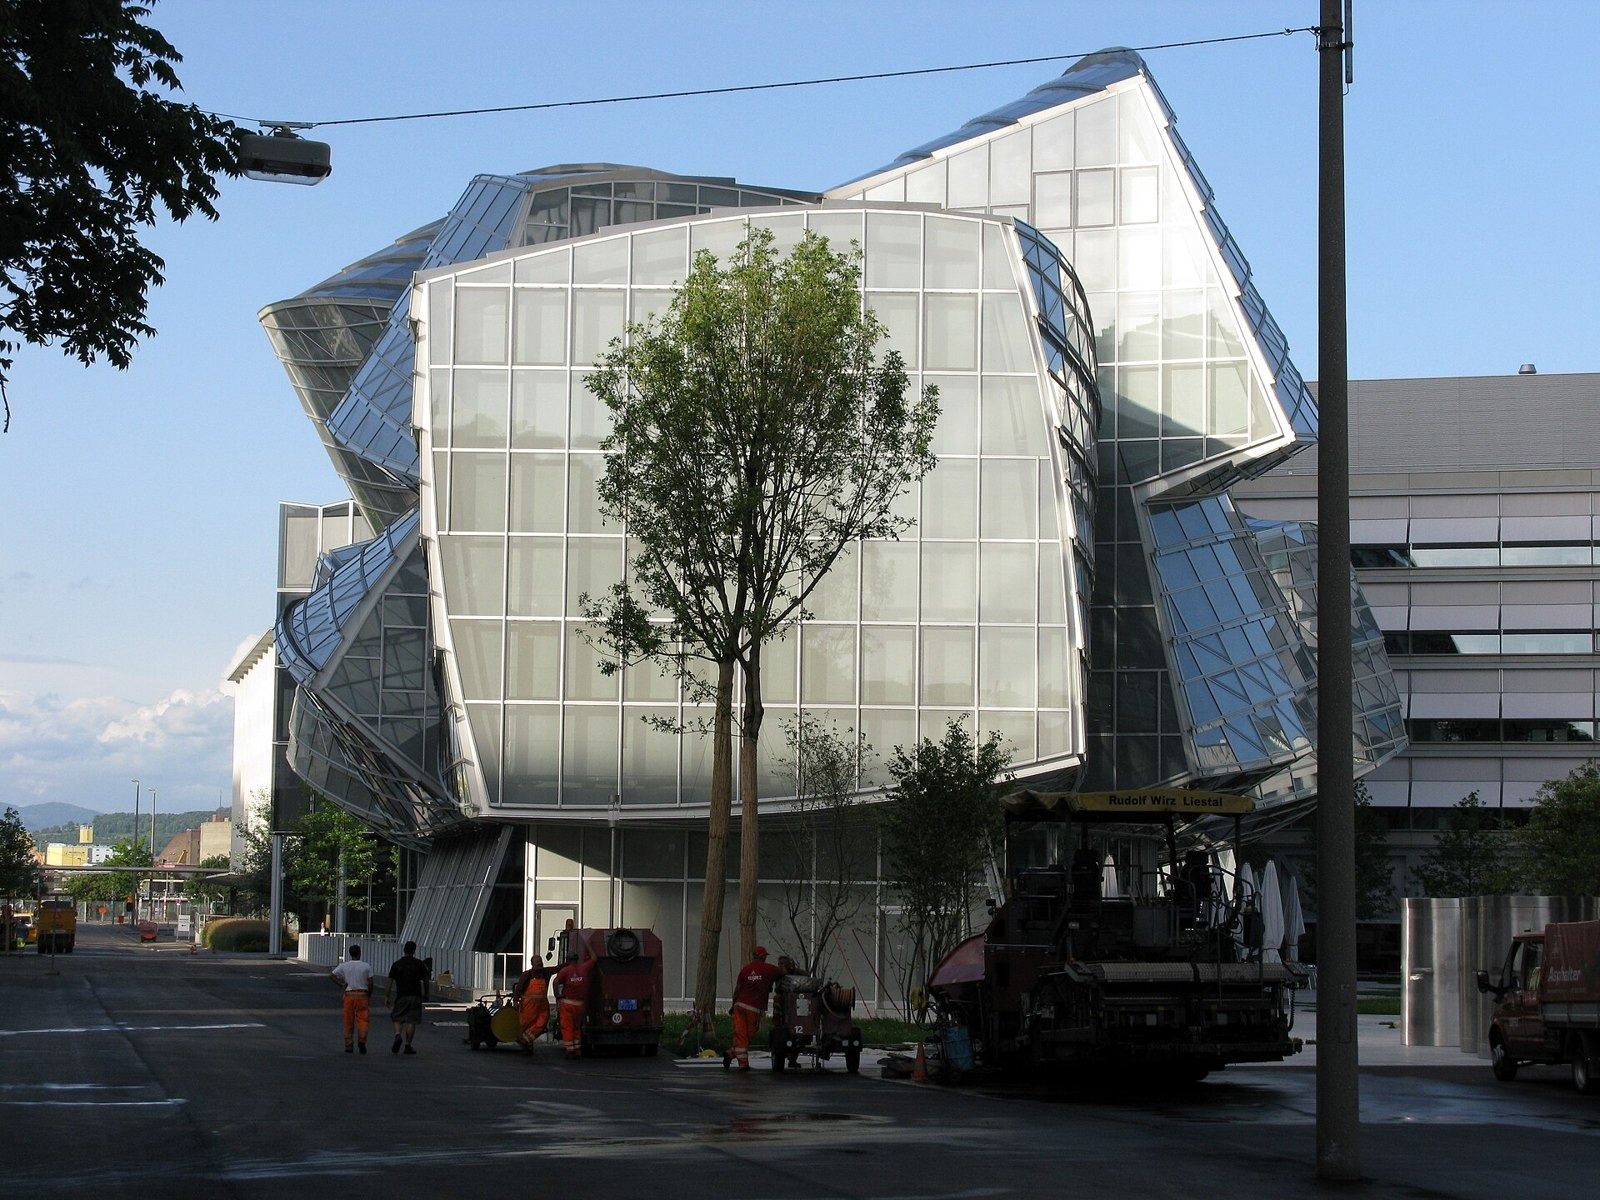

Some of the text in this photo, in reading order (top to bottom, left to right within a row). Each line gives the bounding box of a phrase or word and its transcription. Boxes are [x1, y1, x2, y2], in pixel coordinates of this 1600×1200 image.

[1108, 795, 1223, 807] Rudolf Wirz Liestal
[794, 1025, 803, 1034] 12
